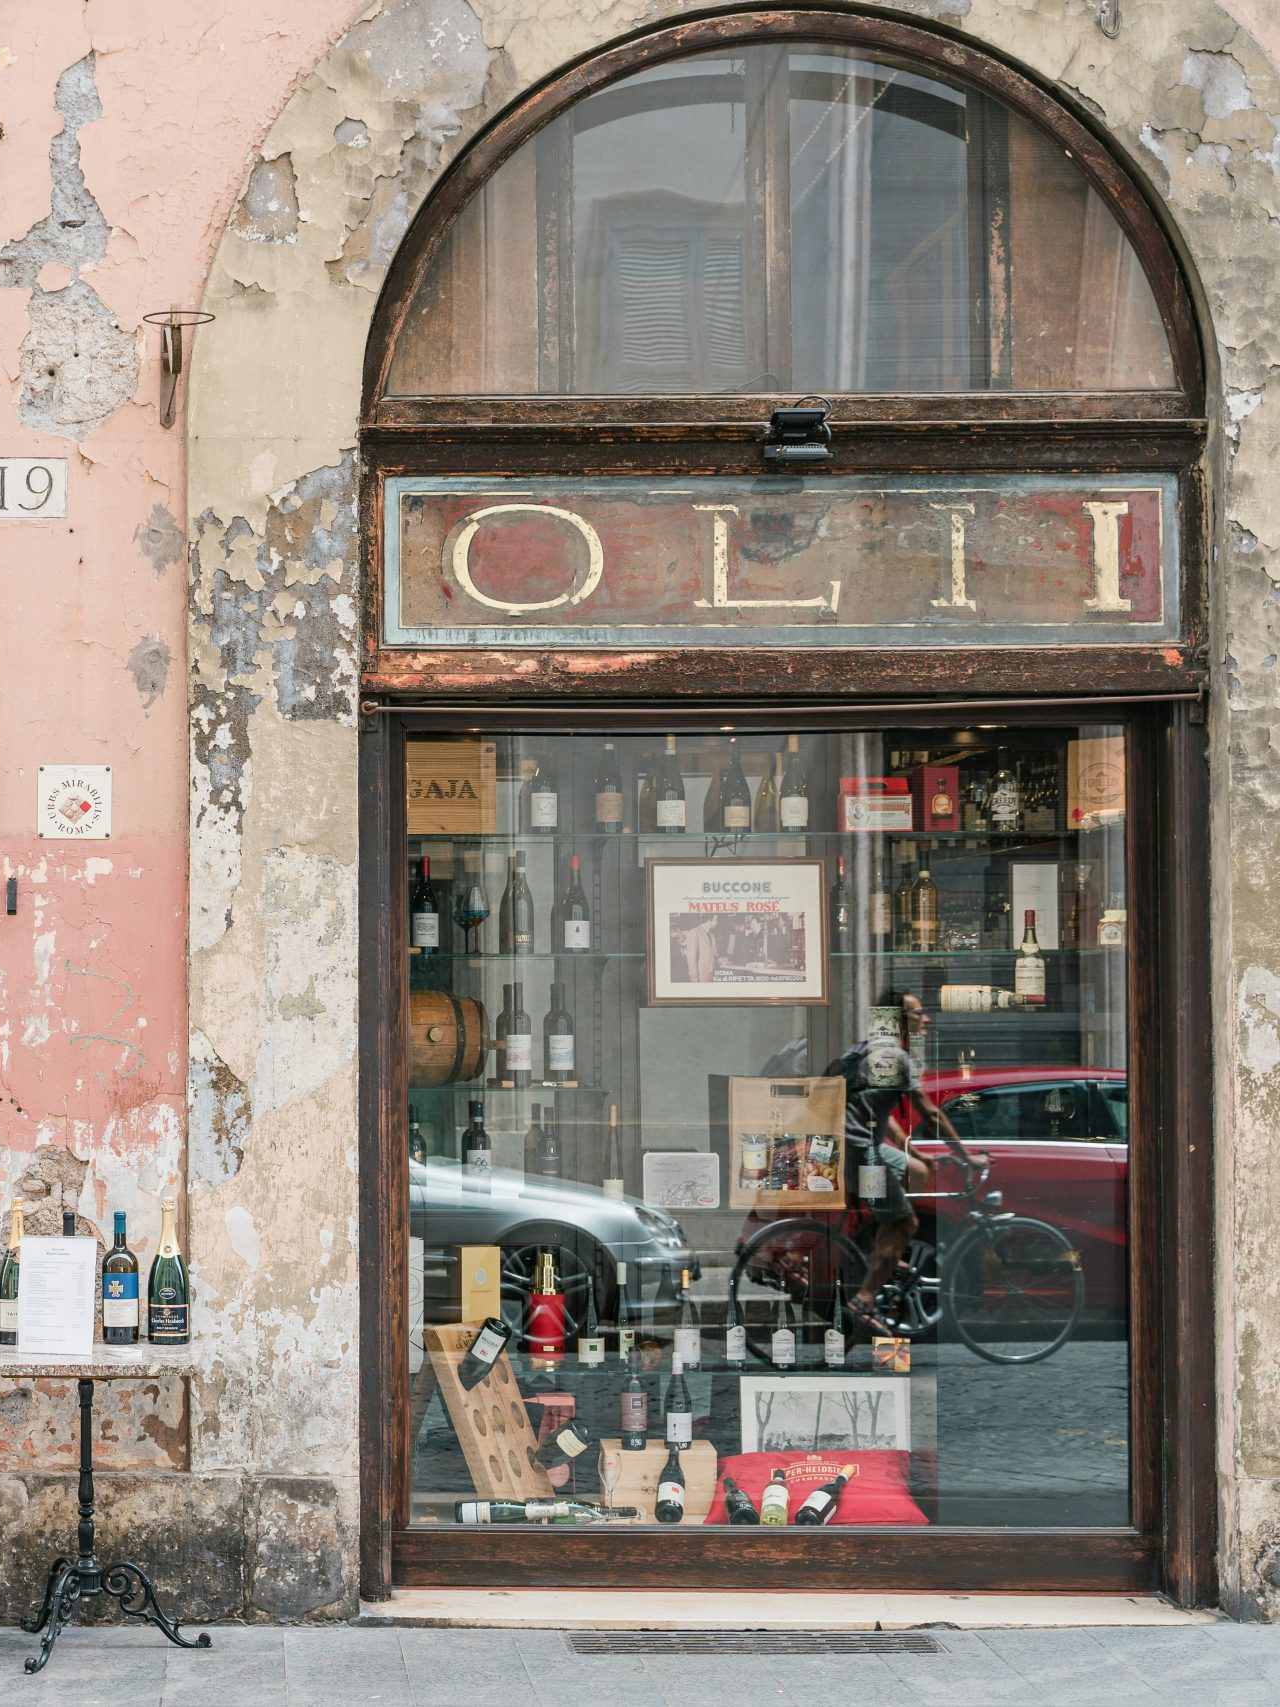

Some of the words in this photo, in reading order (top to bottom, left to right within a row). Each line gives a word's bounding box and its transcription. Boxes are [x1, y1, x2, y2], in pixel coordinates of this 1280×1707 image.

[448, 500, 1133, 616] OLII
[409, 779, 479, 799] GAJA
[47, 788, 60, 820] URBS
[61, 779, 103, 821] MIRABILIS
[57, 823, 93, 835] ROMA
[703, 881, 772, 893] BUCCONE
[688, 902, 739, 912] MATEUS
